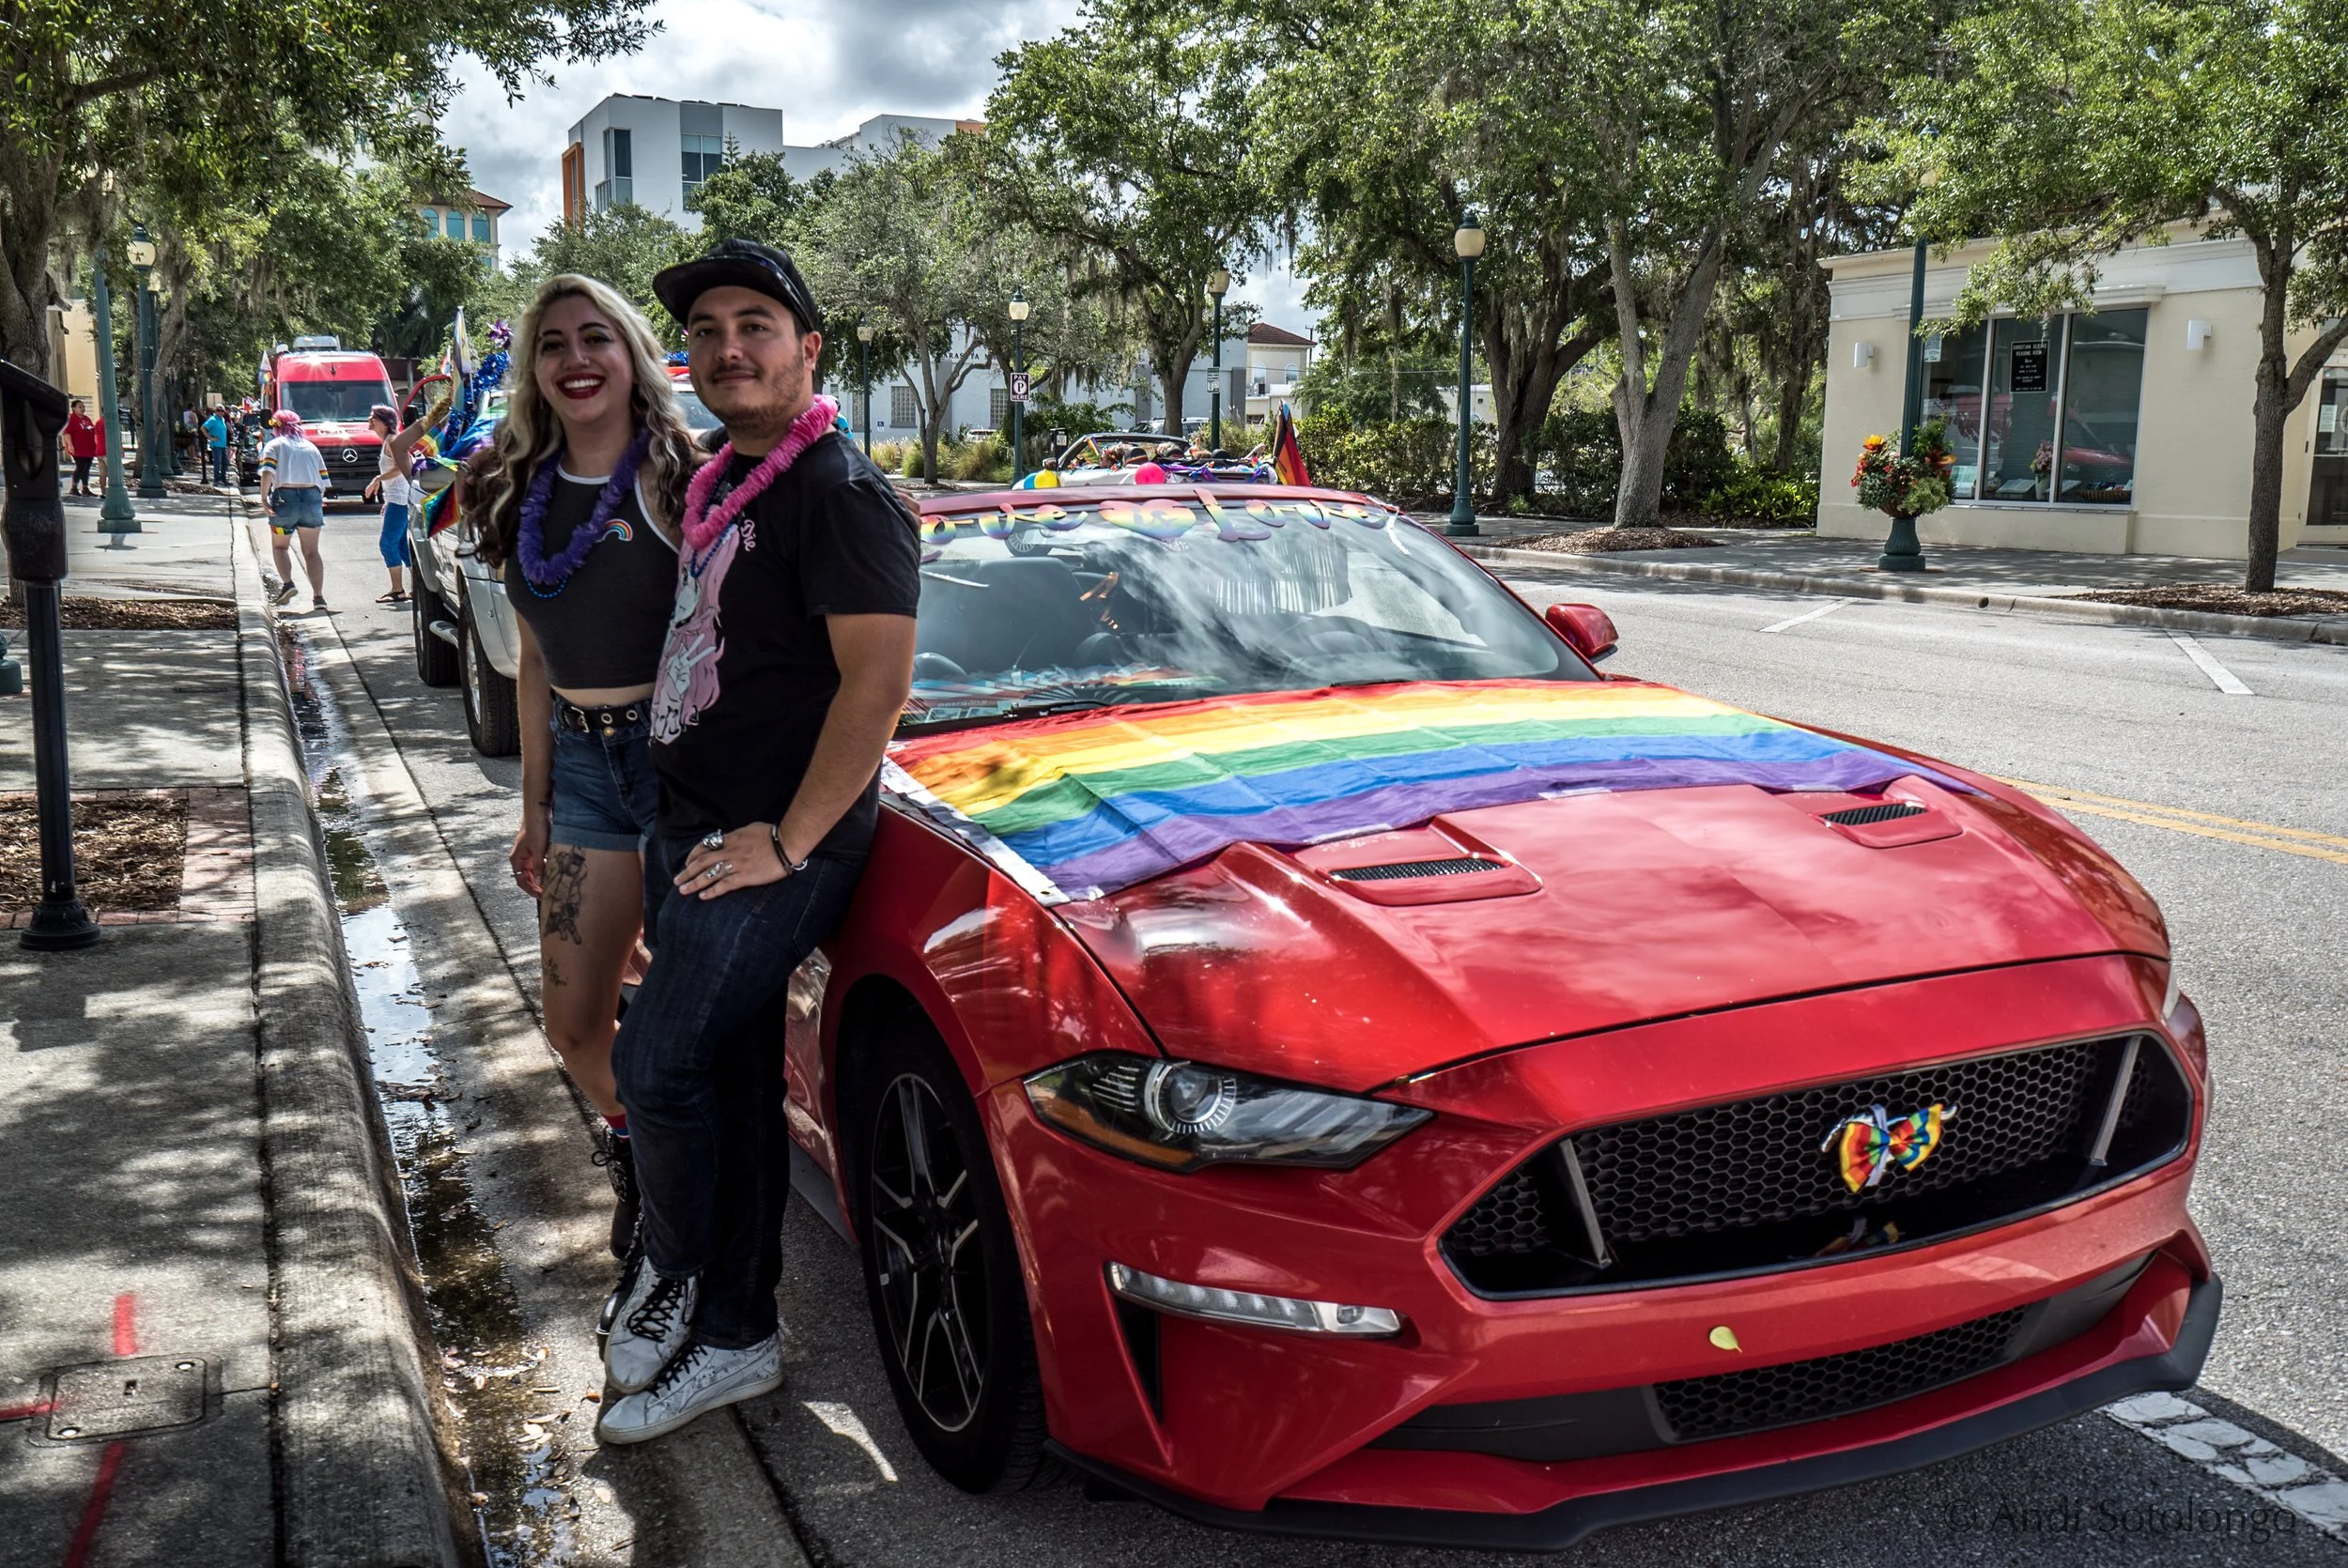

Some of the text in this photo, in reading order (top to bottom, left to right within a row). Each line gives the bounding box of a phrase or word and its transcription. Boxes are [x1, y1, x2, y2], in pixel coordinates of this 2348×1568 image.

[1017, 382, 1024, 392] P
[920, 501, 1089, 562] ove
[1193, 487, 1387, 543] Love
